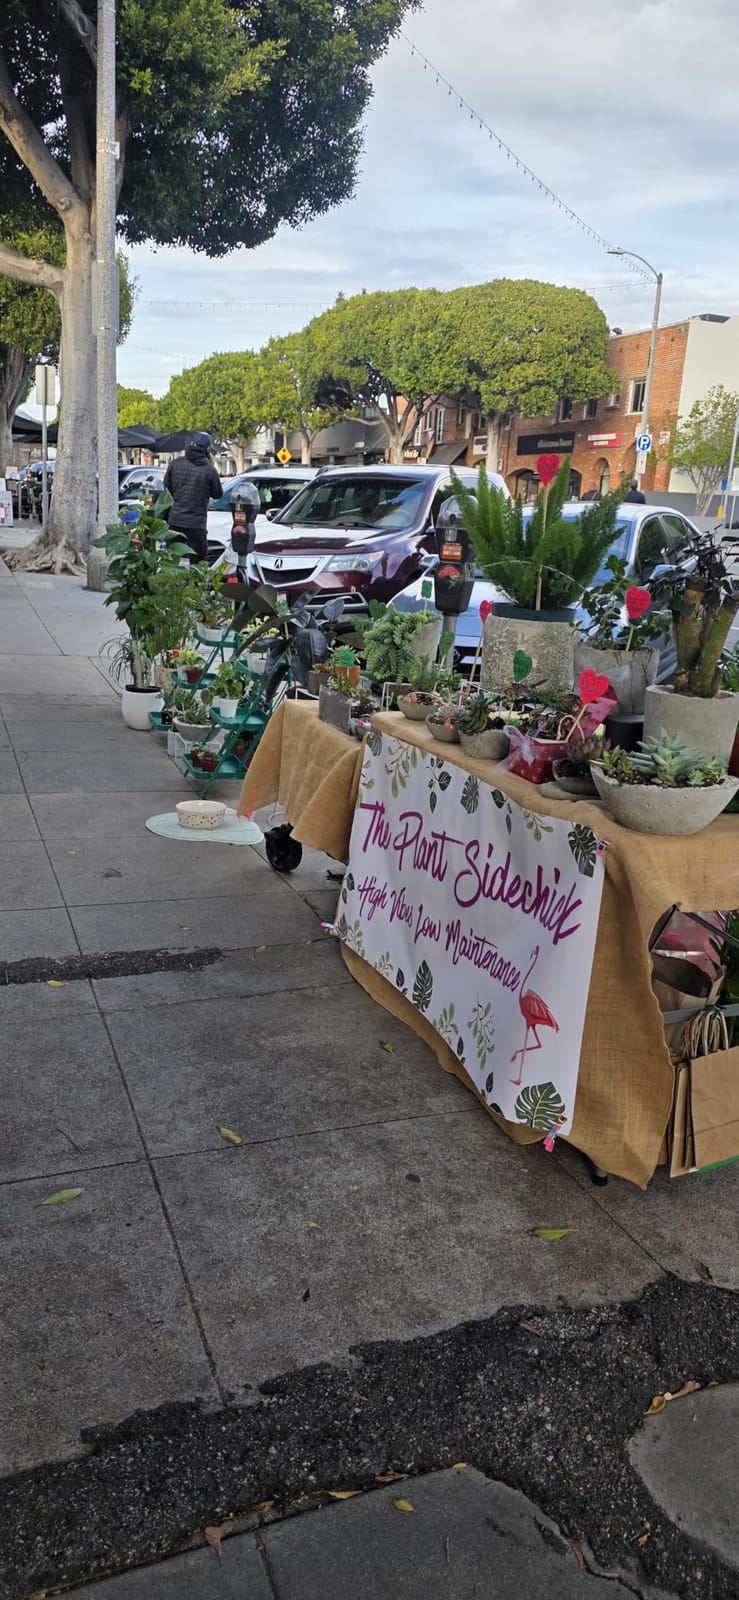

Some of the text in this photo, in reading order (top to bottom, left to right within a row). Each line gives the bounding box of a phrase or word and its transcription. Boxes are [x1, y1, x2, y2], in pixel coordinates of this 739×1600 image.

[357, 876, 521, 992] High Vibes Low Maintenance
[359, 800, 583, 946] The Plant Sidechick
